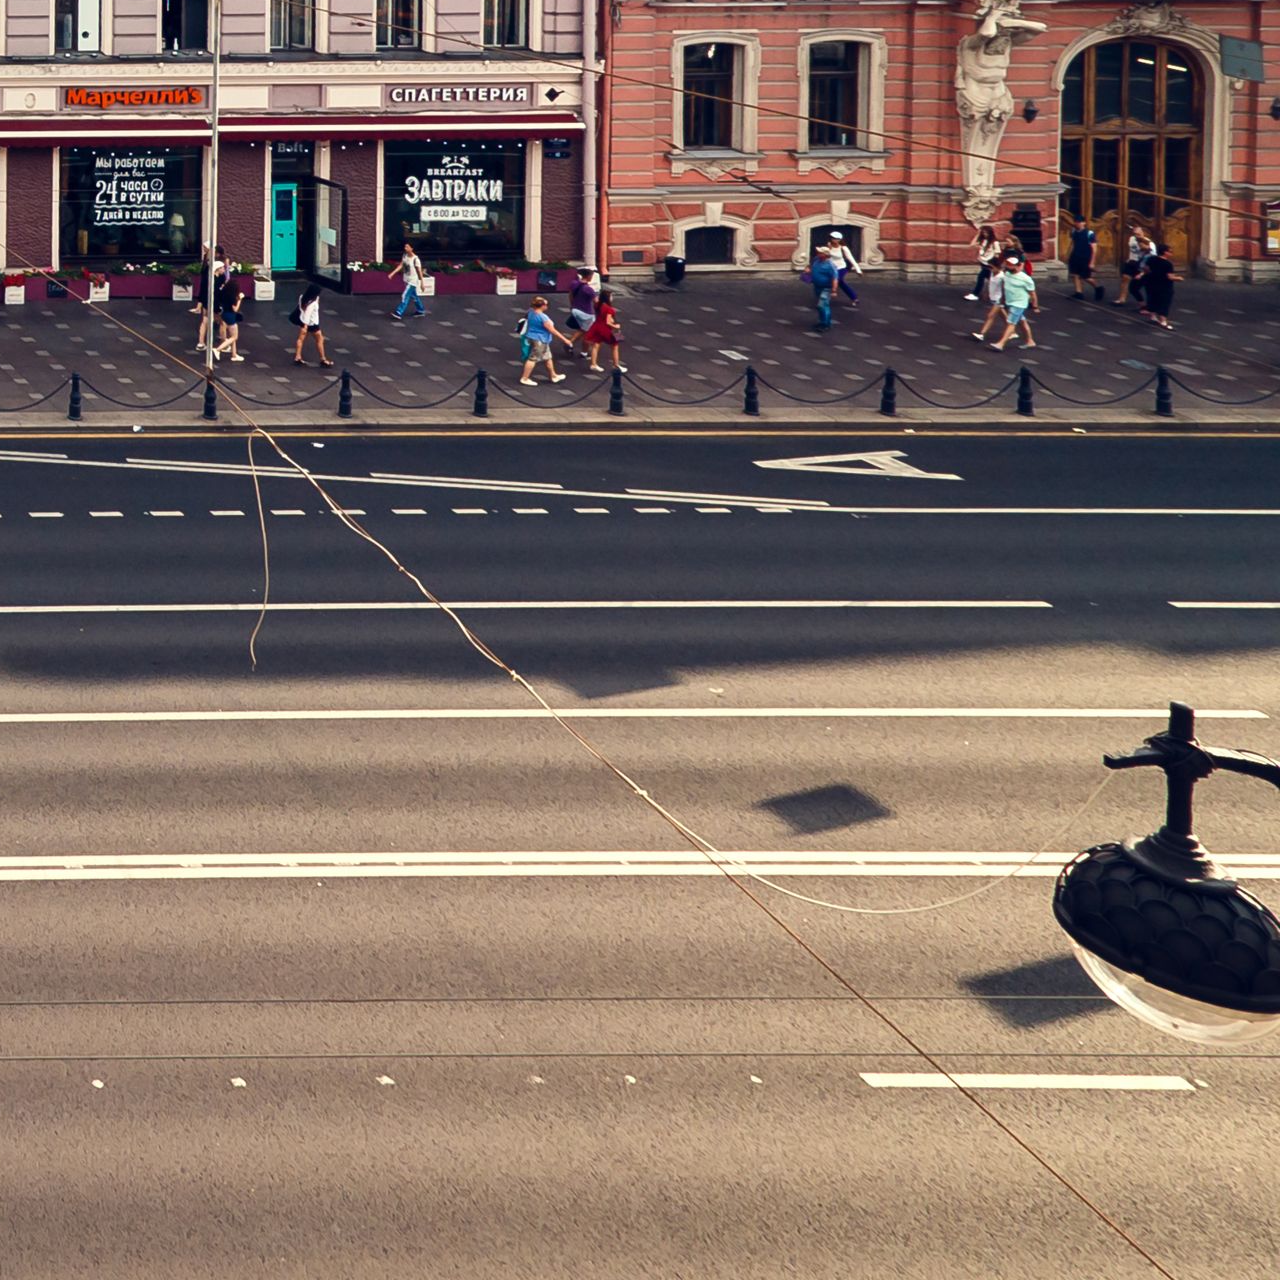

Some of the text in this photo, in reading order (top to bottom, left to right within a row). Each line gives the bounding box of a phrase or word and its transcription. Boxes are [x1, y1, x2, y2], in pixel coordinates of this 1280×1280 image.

[67, 86, 203, 109] Марчелли's
[391, 87, 528, 102] СПАГЕТТЕРИЯ
[95, 157, 165, 170] Мы работаем
[427, 168, 483, 176] BREAKFAST
[95, 180, 148, 204] 24 часа
[95, 210, 101, 221] 7
